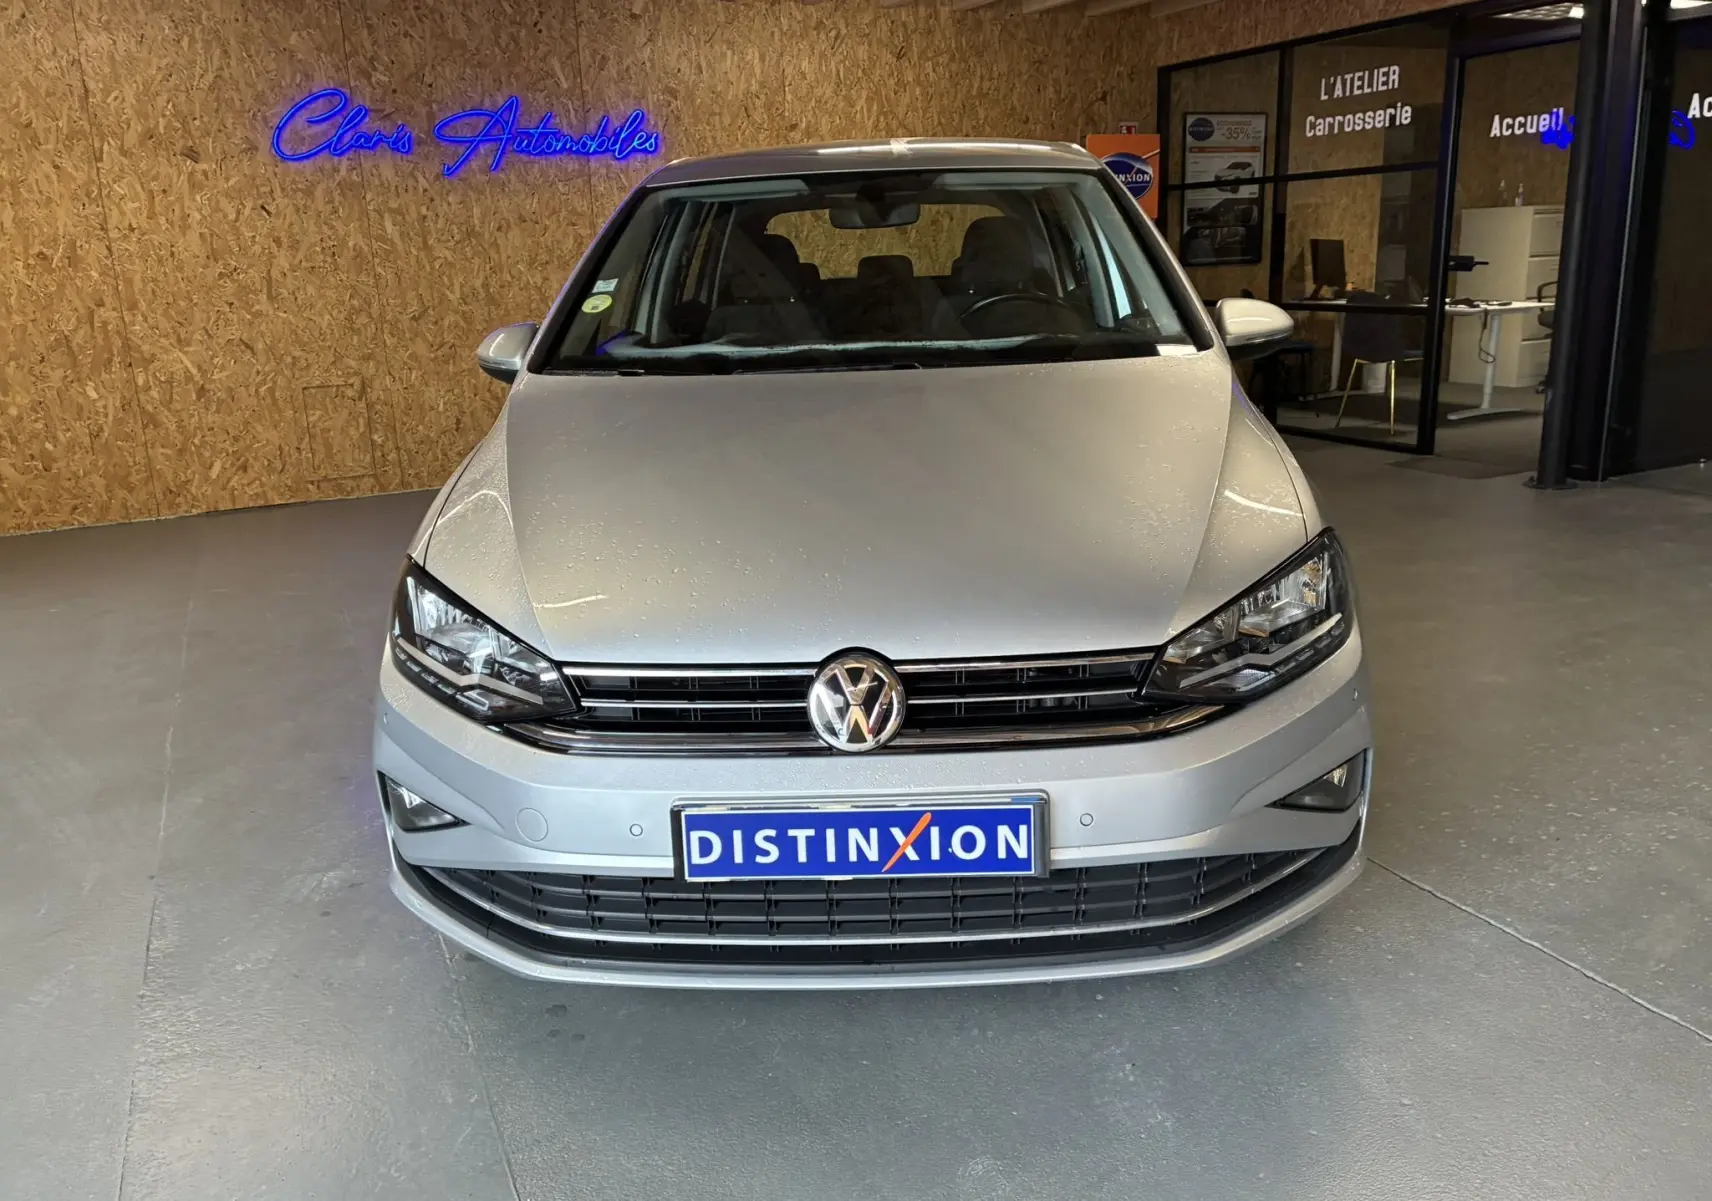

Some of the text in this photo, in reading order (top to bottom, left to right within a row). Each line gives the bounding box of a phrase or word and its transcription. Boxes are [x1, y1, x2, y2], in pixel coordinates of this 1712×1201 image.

[1320, 65, 1400, 100] L'ATELIER
[272, 89, 659, 177] Claris Automobiles
[1305, 102, 1412, 137] Carrosserie
[1490, 107, 1564, 137] Accueil
[689, 812, 1029, 872] DISTINXION
